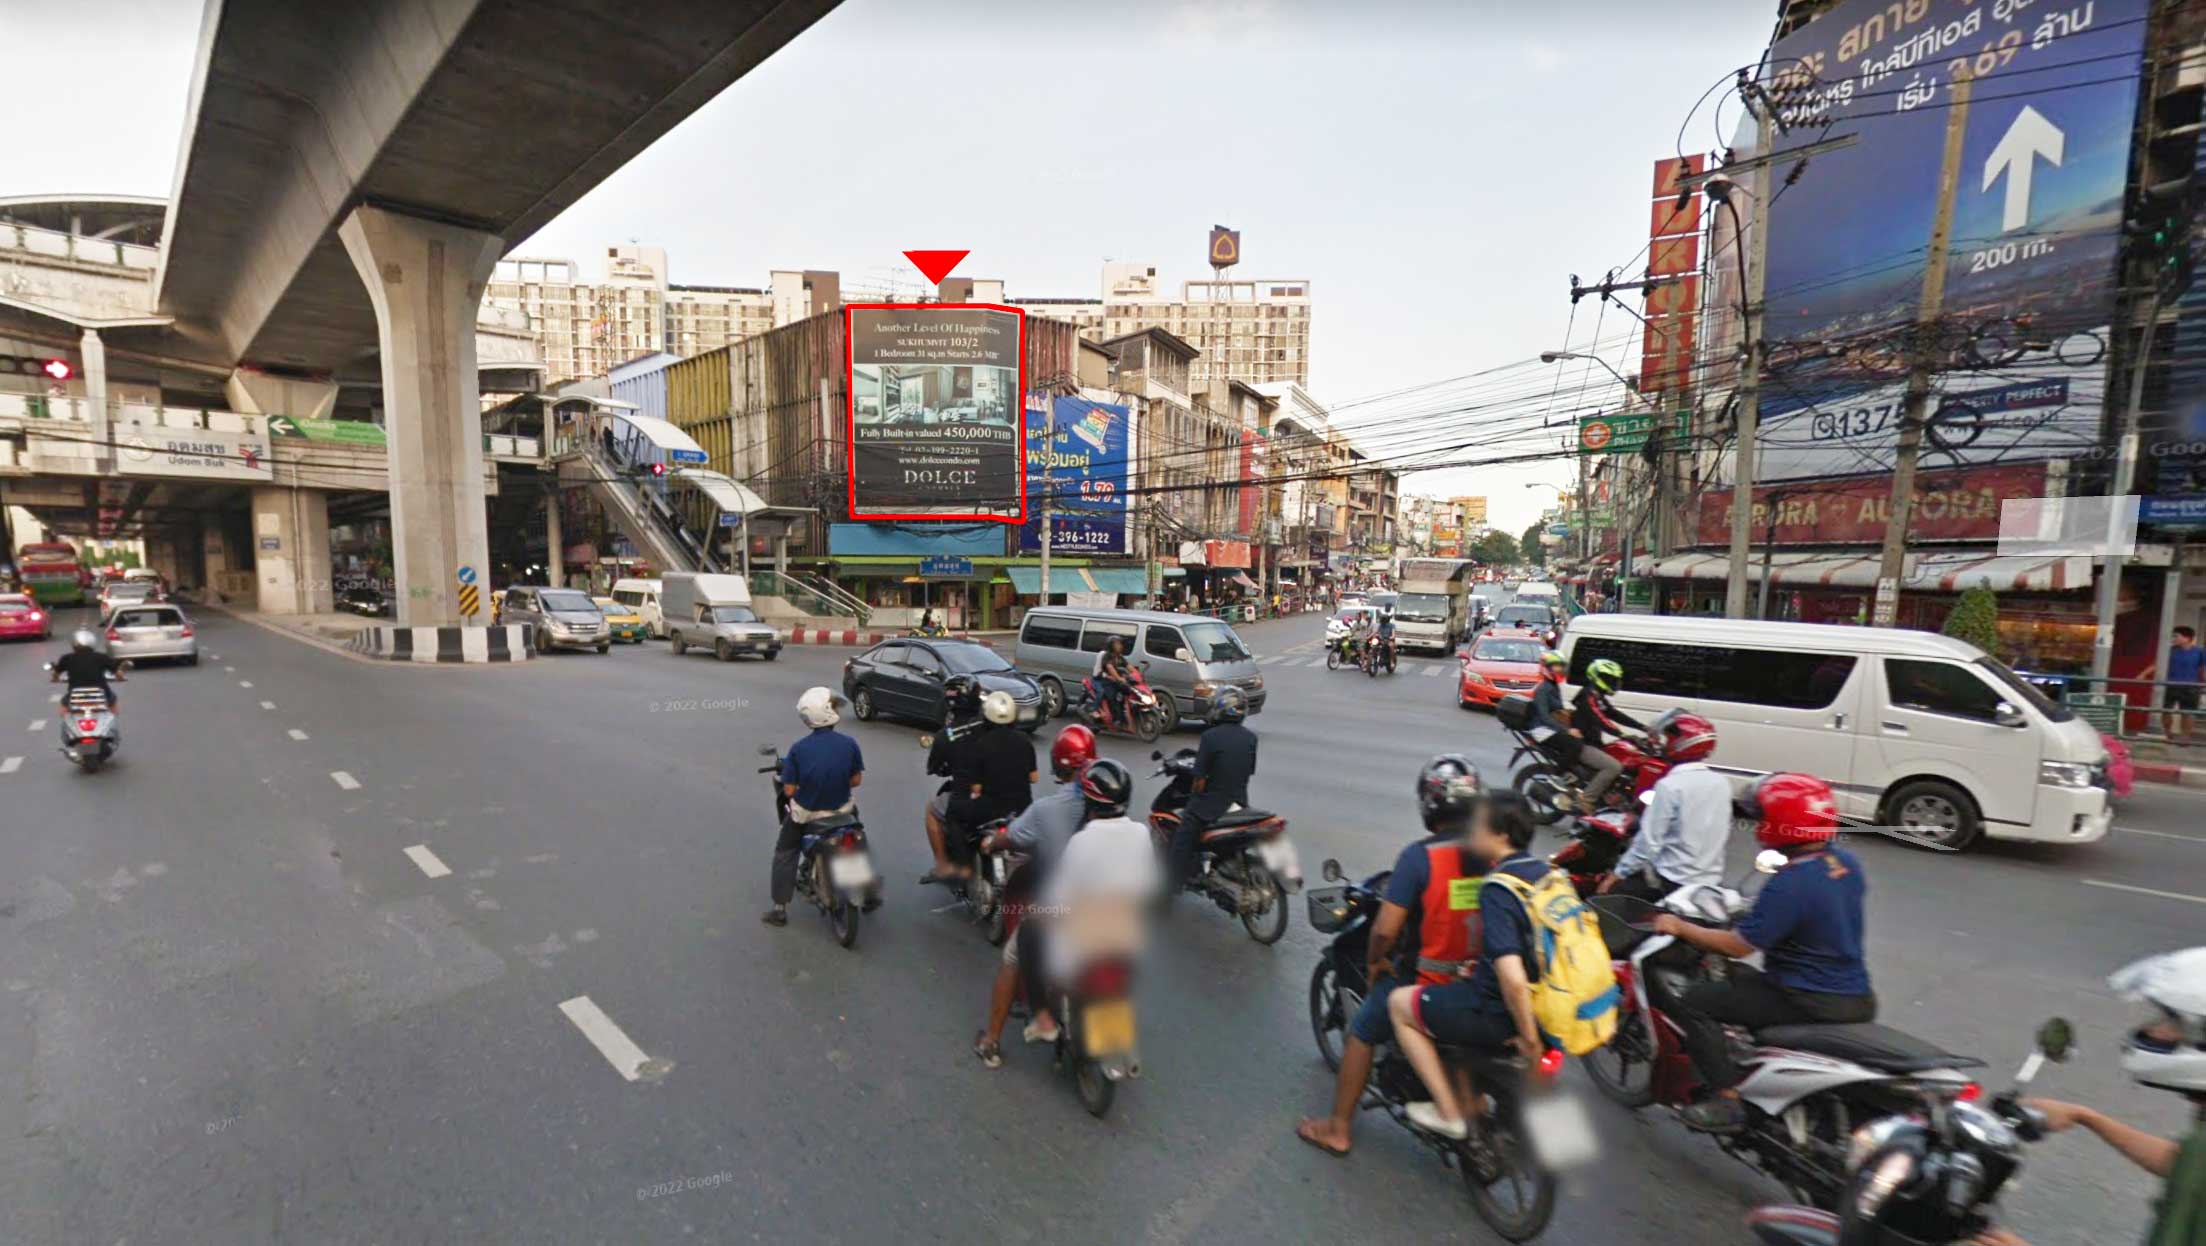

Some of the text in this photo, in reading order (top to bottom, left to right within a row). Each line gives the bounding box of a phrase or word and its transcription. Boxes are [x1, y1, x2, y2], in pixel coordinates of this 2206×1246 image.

[1838, 0, 1929, 62] สกาย
[1860, 7, 1982, 89] ใกล้บีทีเอส
[1896, 72, 1937, 111] เริ่ม
[2031, 0, 2095, 50] ล้าน
[1970, 238, 2055, 273] 200 m.
[874, 323, 1000, 335] Another Level Of Happiness
[896, 337, 979, 349] SUKHUMVIT 103/2
[880, 349, 915, 358] Bedroom
[917, 350, 926, 358] 31
[947, 349, 969, 359] Starts
[971, 350, 983, 359] 2.6
[2006, 384, 2062, 401] PERFECT
[860, 427, 1011, 440] Fully Built-in valued 450,000 THB
[168, 456, 225, 467] Udom Suk
[904, 469, 976, 484] DOLCE
[1722, 487, 1995, 527] ARRA AUORA
[1038, 531, 1110, 544] -396-1222
